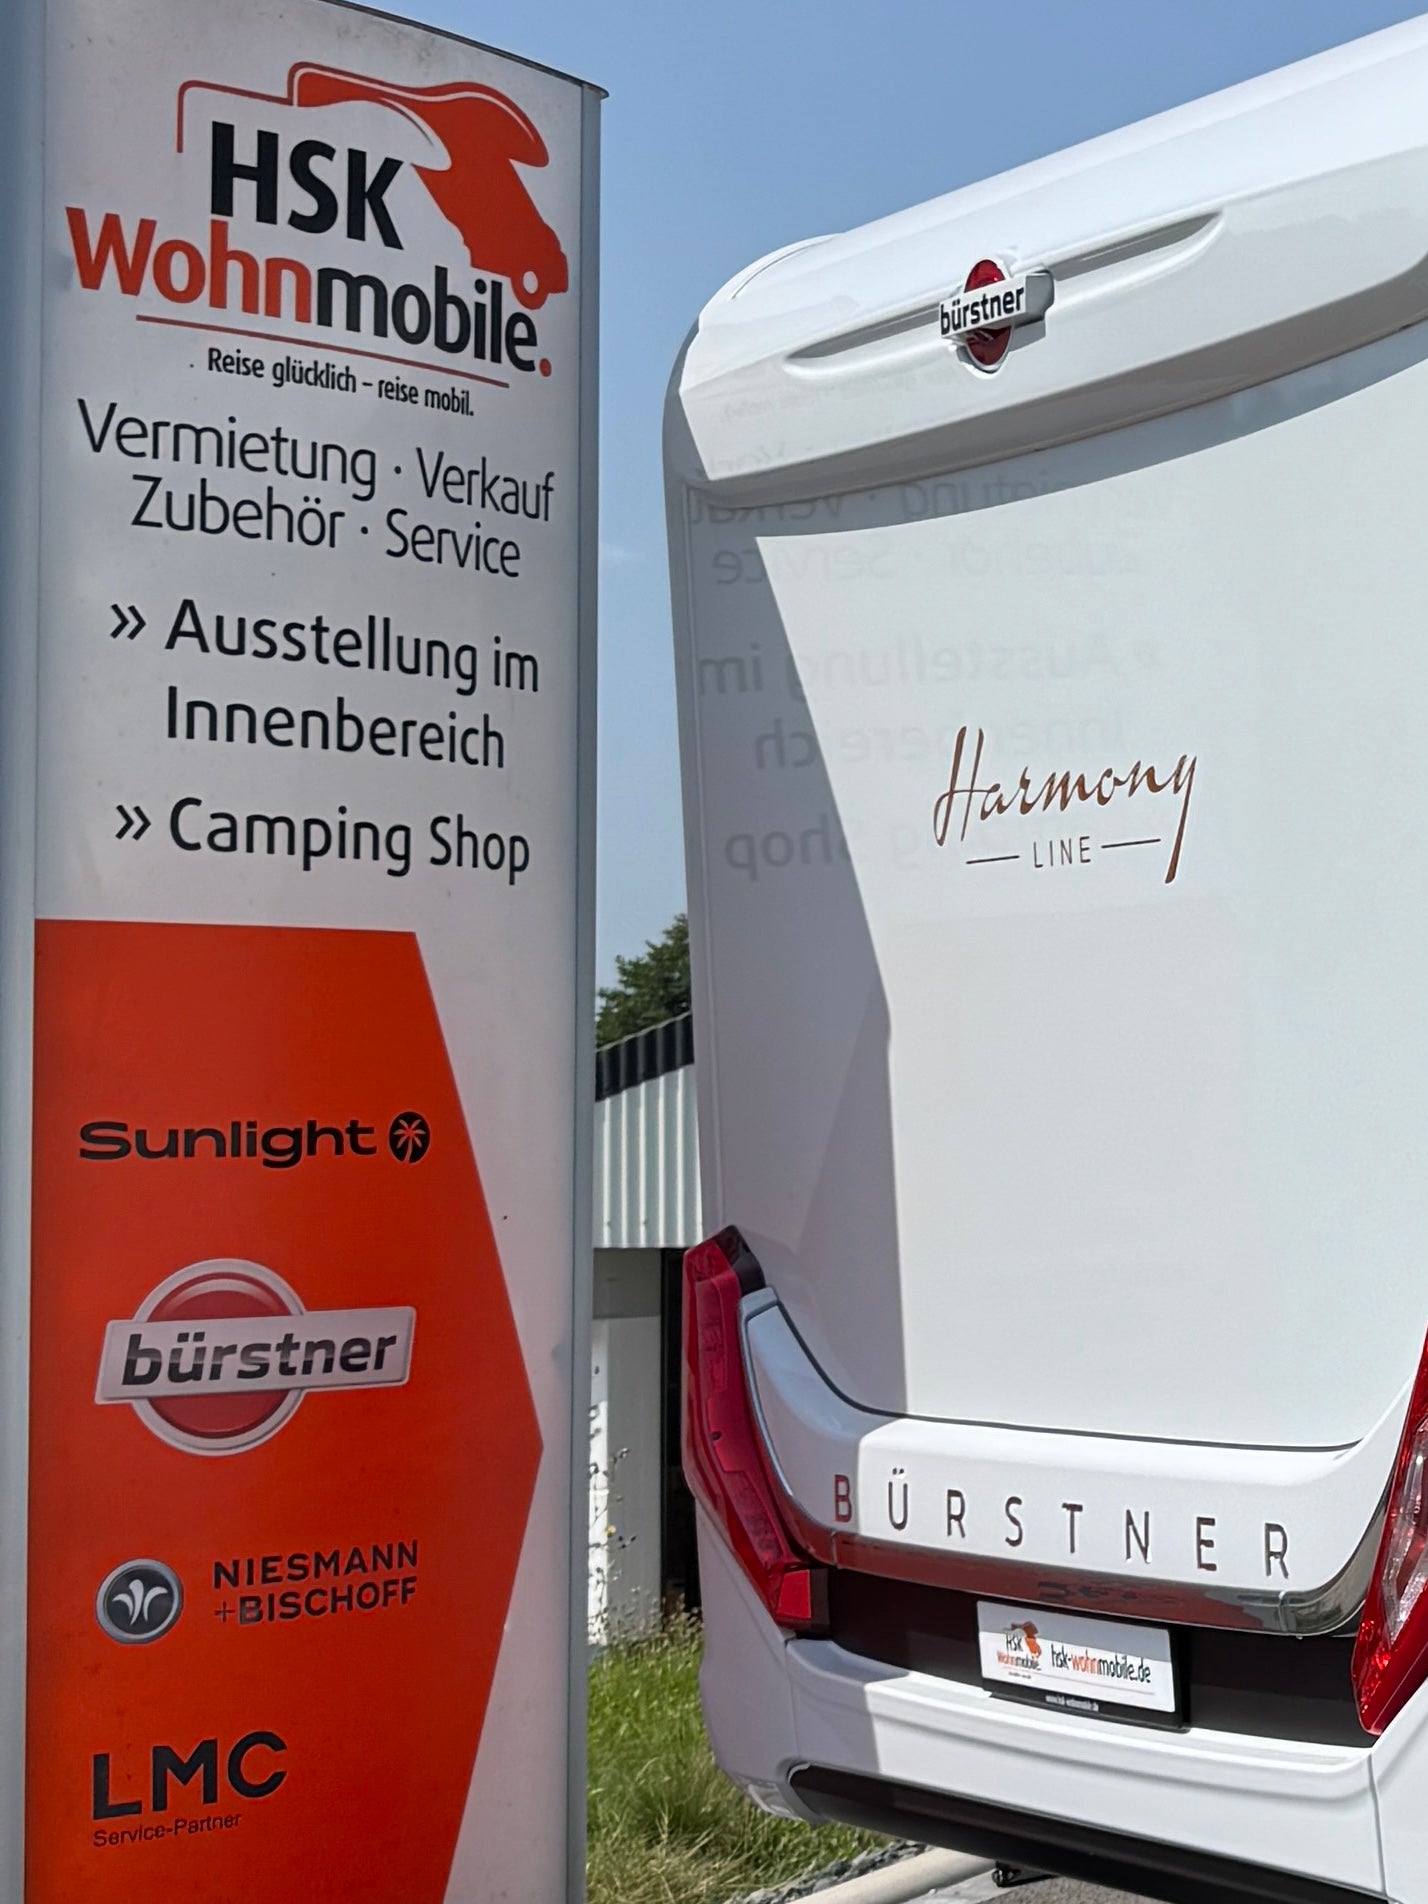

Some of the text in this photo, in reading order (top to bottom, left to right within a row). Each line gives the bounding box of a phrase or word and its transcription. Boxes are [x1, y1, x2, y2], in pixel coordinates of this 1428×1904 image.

[210, 120, 405, 251] HSK
[940, 287, 1024, 335] bürstner
[207, 347, 475, 417] Reise glücklich reise mobil.
[77, 398, 554, 522] Vermietung Verkauf
[130, 473, 521, 578] Zubehör Service
[164, 598, 539, 696] Ausstellung im
[166, 685, 505, 769] Innenbereich
[169, 797, 530, 885] Camping Shop
[933, 725, 1198, 884] Harmony
[1033, 836, 1092, 868] LINE
[79, 1120, 378, 1169] Sunlight
[121, 1331, 398, 1386] bürstner
[213, 1539, 419, 1590] NIESMANN
[833, 1467, 1290, 1580] BÜRSTNER
[1050, 1643, 1152, 1684] hsk-wohnmobile.de
[92, 1730, 288, 1821] LMC
[92, 1814, 243, 1848] Service-Partner
